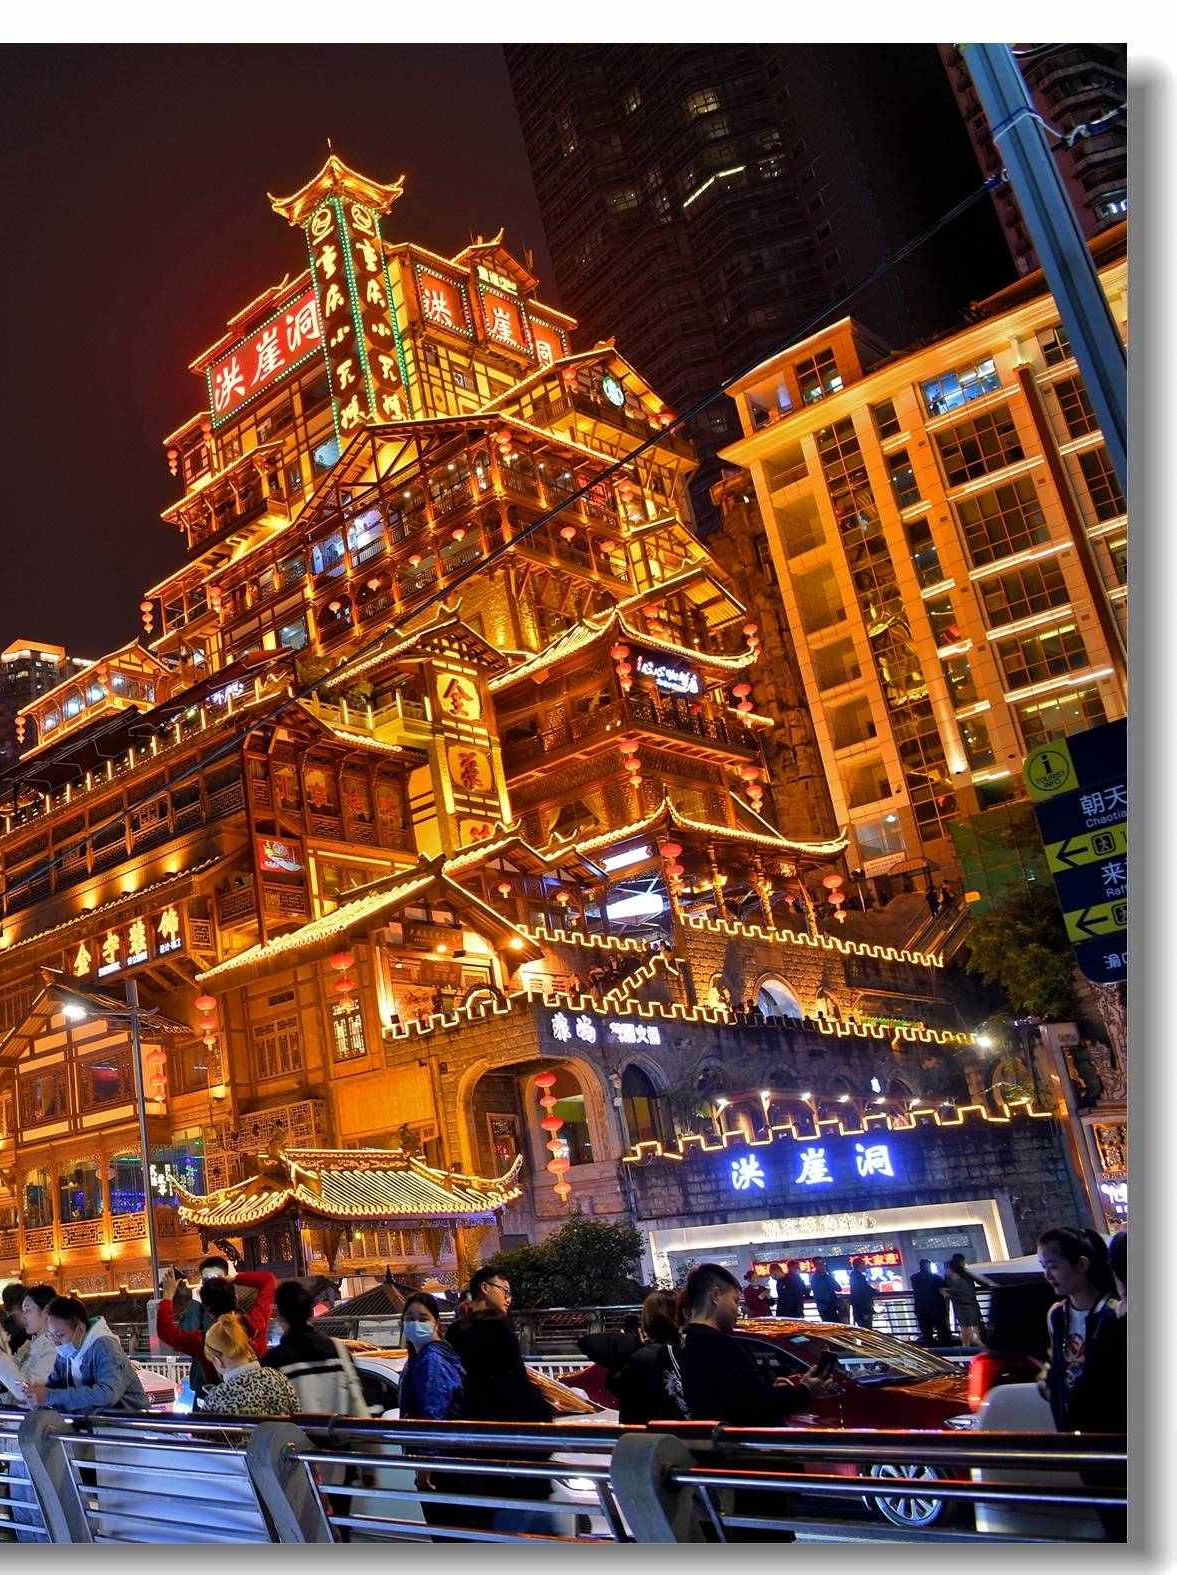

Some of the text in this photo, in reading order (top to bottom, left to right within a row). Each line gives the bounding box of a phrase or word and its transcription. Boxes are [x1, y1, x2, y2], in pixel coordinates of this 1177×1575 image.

[215, 299, 321, 412] 洪崖洞
[1101, 857, 1127, 885] 来
[731, 1143, 895, 1190] 洪崖洞
